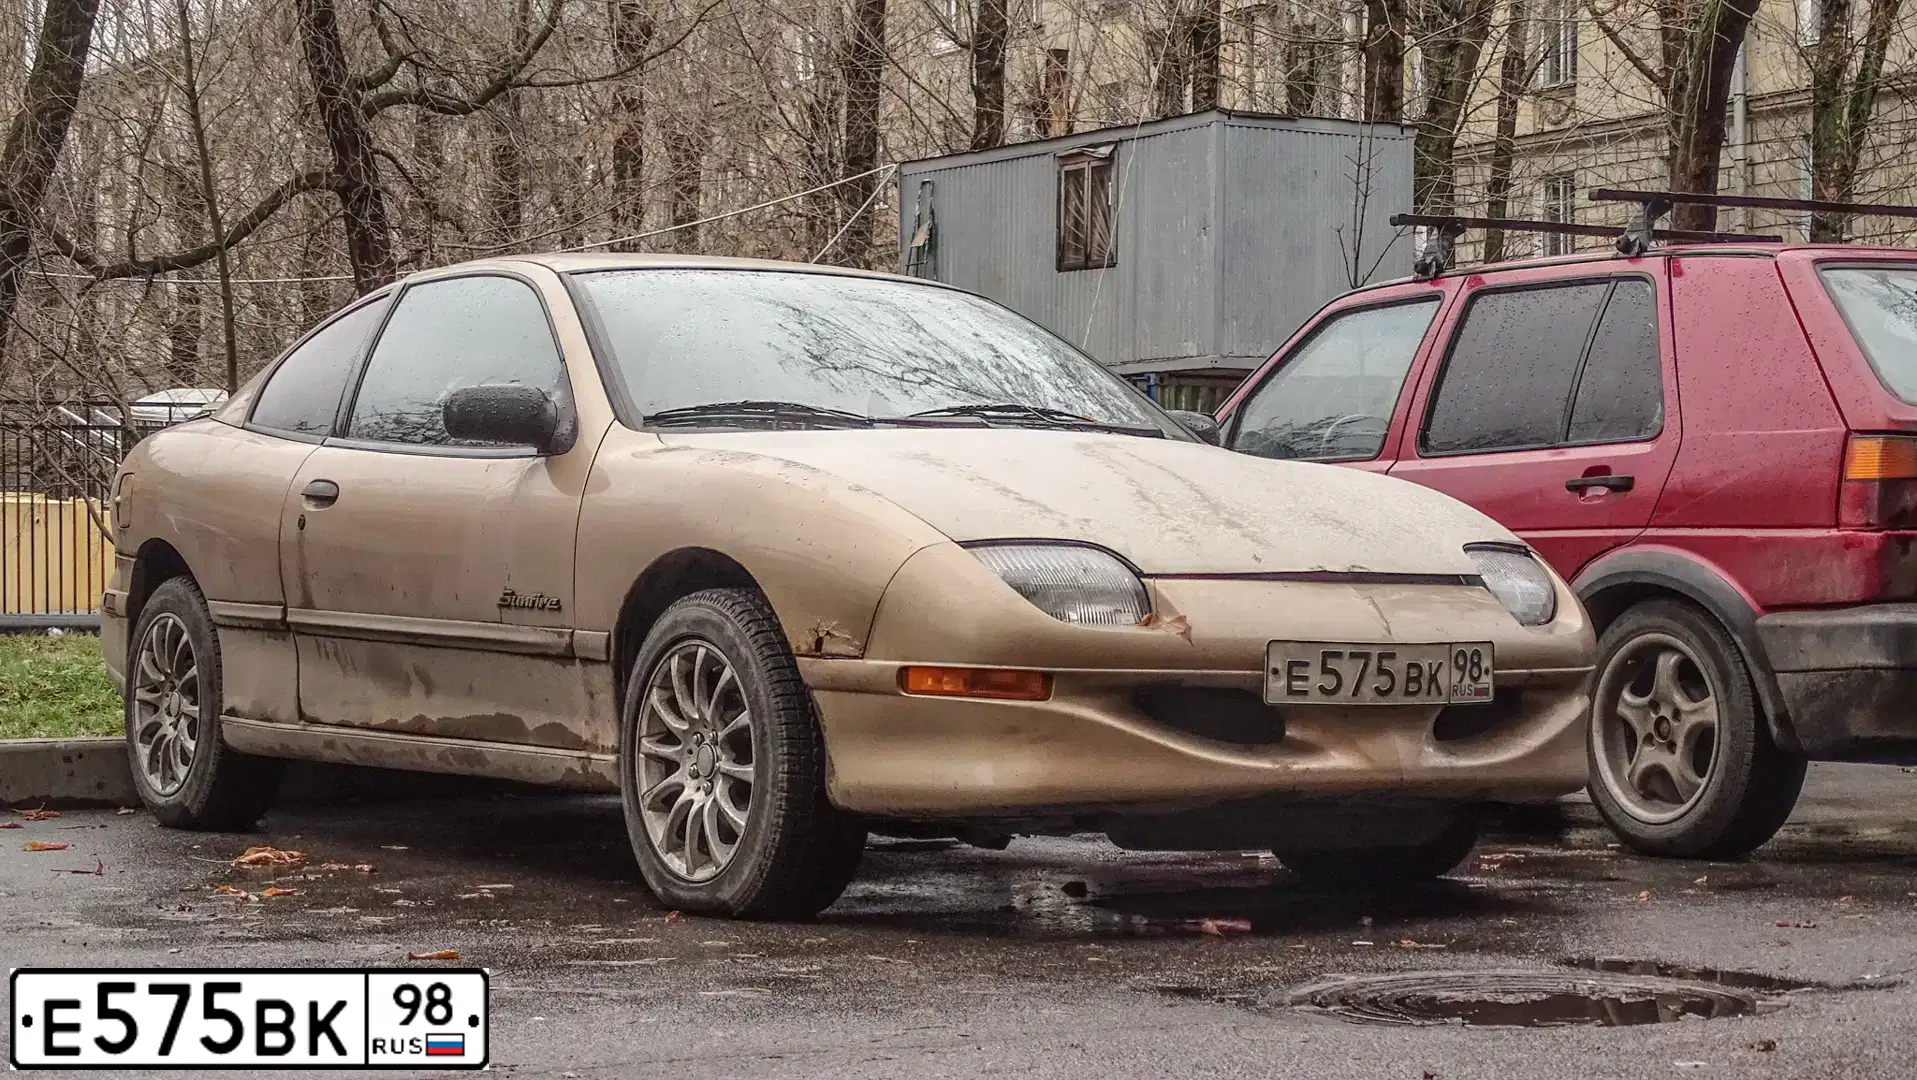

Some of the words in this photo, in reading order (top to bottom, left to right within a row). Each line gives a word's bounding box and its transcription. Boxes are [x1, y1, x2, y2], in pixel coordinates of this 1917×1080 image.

[497, 587, 562, 611] Sunfire
[1453, 648, 1483, 684] 98
[1451, 684, 1474, 697] RUS
